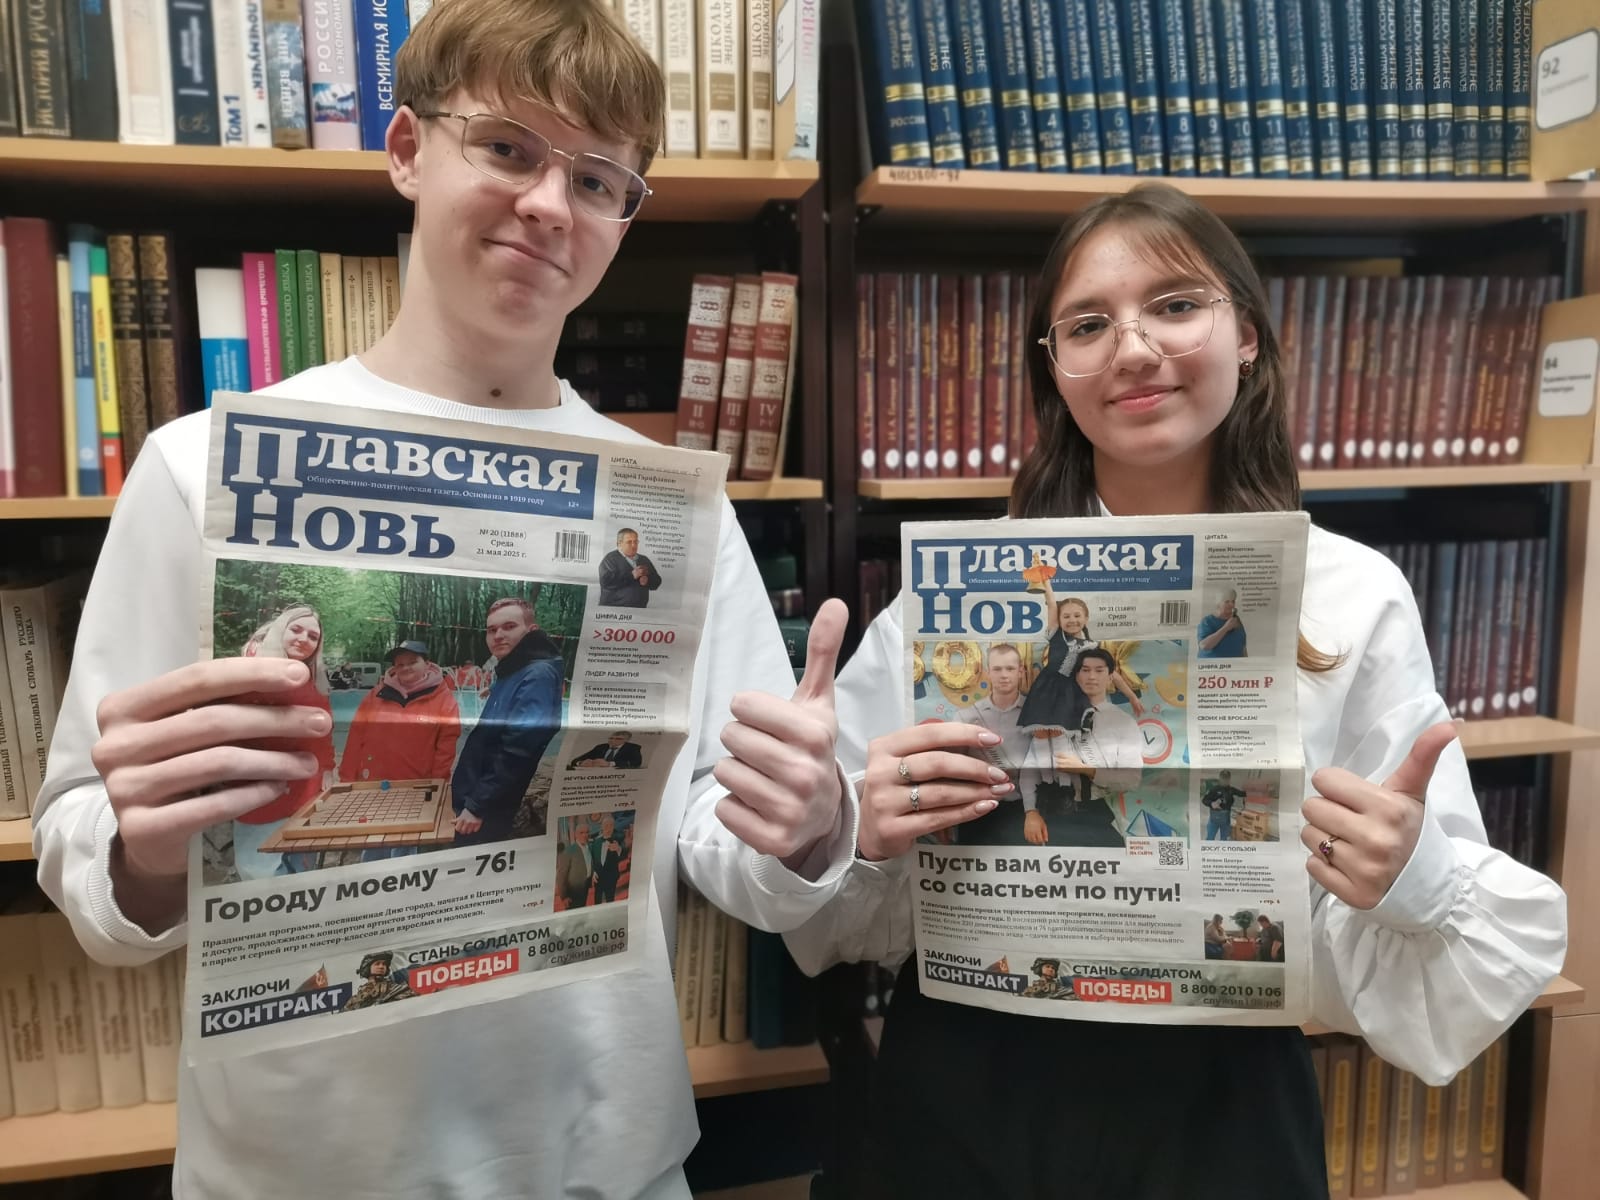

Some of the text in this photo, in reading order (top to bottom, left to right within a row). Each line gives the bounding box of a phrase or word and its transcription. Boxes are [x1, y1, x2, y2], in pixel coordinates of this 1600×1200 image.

[373, 22, 393, 111] ВСЕМИРНАЯ
[1542, 57, 1560, 79] 92
[30, 48, 54, 126] ИСТОРИЯ
[223, 95, 240, 104] 1
[942, 106, 951, 122] 1
[1019, 110, 1028, 126] 3
[1047, 113, 1057, 128] 4
[1082, 113, 1091, 130] 5
[1114, 111, 1124, 127] 6
[1146, 115, 1157, 133] 7
[1179, 116, 1189, 133] 8
[1208, 117, 1218, 134] 9
[1234, 121, 1250, 137] 10
[1266, 119, 1282, 135] 11
[1384, 123, 1399, 138] 15
[1410, 123, 1425, 138] 16
[1437, 122, 1451, 136] 17
[1461, 125, 1476, 139] 18
[1488, 125, 1502, 139] 19
[1514, 125, 1529, 140] 20
[258, 260, 268, 306] ШКОЛЬНЫЙ
[281, 262, 290, 292] ЯЗЫКА
[304, 263, 317, 338] РУССКОГО ЯЗЫКА
[284, 294, 294, 337] РУССКОГО
[692, 404, 703, 418] II
[727, 402, 741, 417] III
[760, 403, 777, 417] IV
[230, 423, 584, 494] Плавская
[611, 457, 637, 465] ЦИТАТА
[307, 475, 432, 494] Общественно-политическая
[463, 490, 502, 501] Основана
[510, 495, 527, 503] 1919
[527, 498, 544, 506] году
[226, 485, 456, 559] Новь
[490, 529, 500, 537] 20
[486, 549, 503, 557] мая
[504, 550, 520, 558] 2025
[490, 539, 514, 549] Среда
[917, 542, 1181, 589] Плавская
[918, 590, 1044, 635] Нов
[13, 606, 26, 646] РУССКОГО
[641, 630, 676, 644] 000
[1198, 675, 1227, 689] 250
[1231, 679, 1259, 689] млн
[26, 650, 44, 743] ТОЛКОВЫЙ СЛОВАРЬ
[1, 749, 15, 801] ШКОЛЬНЫЙ
[918, 851, 1120, 878] Пусть вам будет
[205, 851, 515, 923] Городу моему 76!
[919, 878, 1181, 905] со счастьем по пути!
[202, 883, 541, 948] Праздничная программа, посвященная Дню города, начатая Центре культуры
[210, 945, 245, 957] досуга,
[248, 933, 314, 951] продолжилась
[317, 924, 365, 938] концертом
[367, 916, 405, 929] артистов
[407, 907, 453, 921] творческих
[455, 898, 504, 911] коллективов
[209, 956, 238, 966] парке
[248, 947, 280, 959] серией
[284, 945, 299, 953] игр
[309, 930, 378, 948] мастер-классов
[380, 927, 395, 935] для
[397, 919, 435, 932] взрослых
[408, 927, 550, 964] СТАНЬ СОЛДАТОМ
[528, 927, 625, 957] 8 800 2010 106
[923, 948, 981, 967] ЗАКЛЮЧИ
[416, 953, 512, 988] ПОБЕДЫ
[927, 963, 1020, 991] КОНТРАКТ
[1073, 965, 1202, 980] СТАНЬ СОЛДАТОМ
[201, 978, 290, 1007] ЗАКЛЮЧИ
[1080, 981, 1166, 1001] ПОБЕДЫ
[1180, 984, 1282, 997] 8 800 2010 106
[205, 988, 343, 1033] КОНТРАКТ
